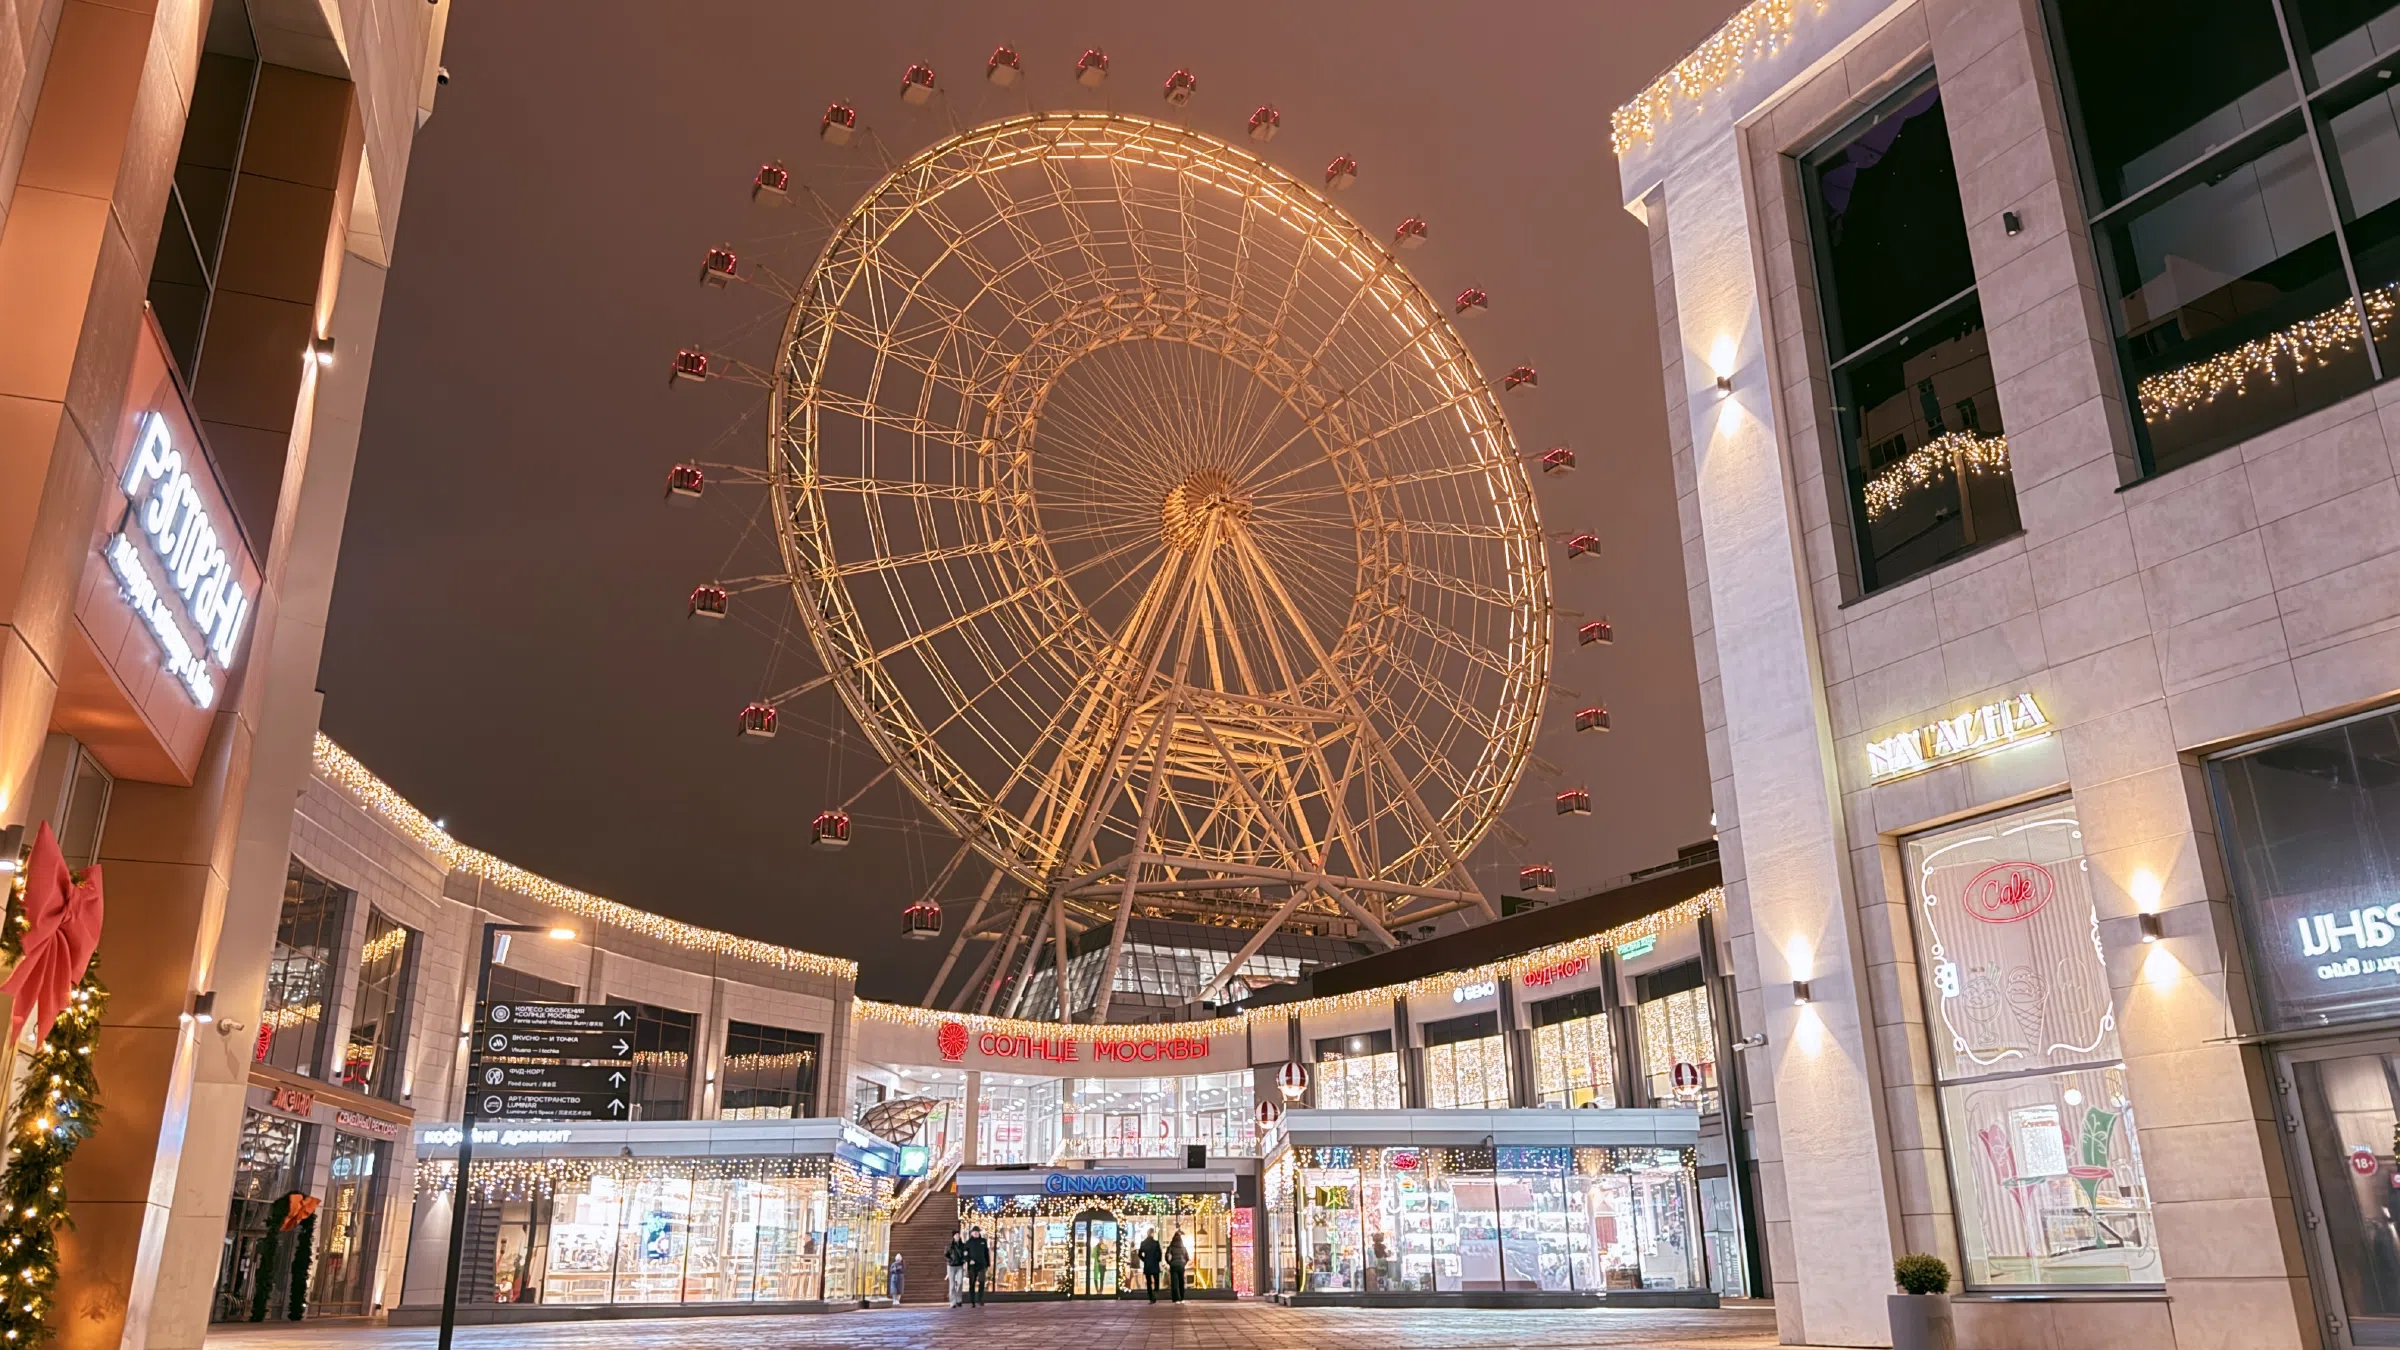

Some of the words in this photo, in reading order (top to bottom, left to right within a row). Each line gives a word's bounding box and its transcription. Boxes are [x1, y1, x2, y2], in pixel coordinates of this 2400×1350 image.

[1865, 692, 2051, 777] NATACHA
[1982, 871, 2036, 914] Cafe
[1522, 954, 1592, 988] ФУД-КОРТ
[515, 1005, 544, 1013] КОЛЕСО
[544, 1006, 585, 1014] ОБОЗРЕНИЯ
[512, 1034, 540, 1042] ВКУСНО
[979, 1034, 1080, 1064] СОЛНЦЕ
[1094, 1036, 1210, 1063] МОСКВЫ
[508, 1095, 581, 1104] АРТ-ПРОСТРАНСТВО
[424, 1127, 499, 1147] кофйня
[2355, 1158, 2374, 1169] 18+
[1045, 1173, 1146, 1193] CINNABON
